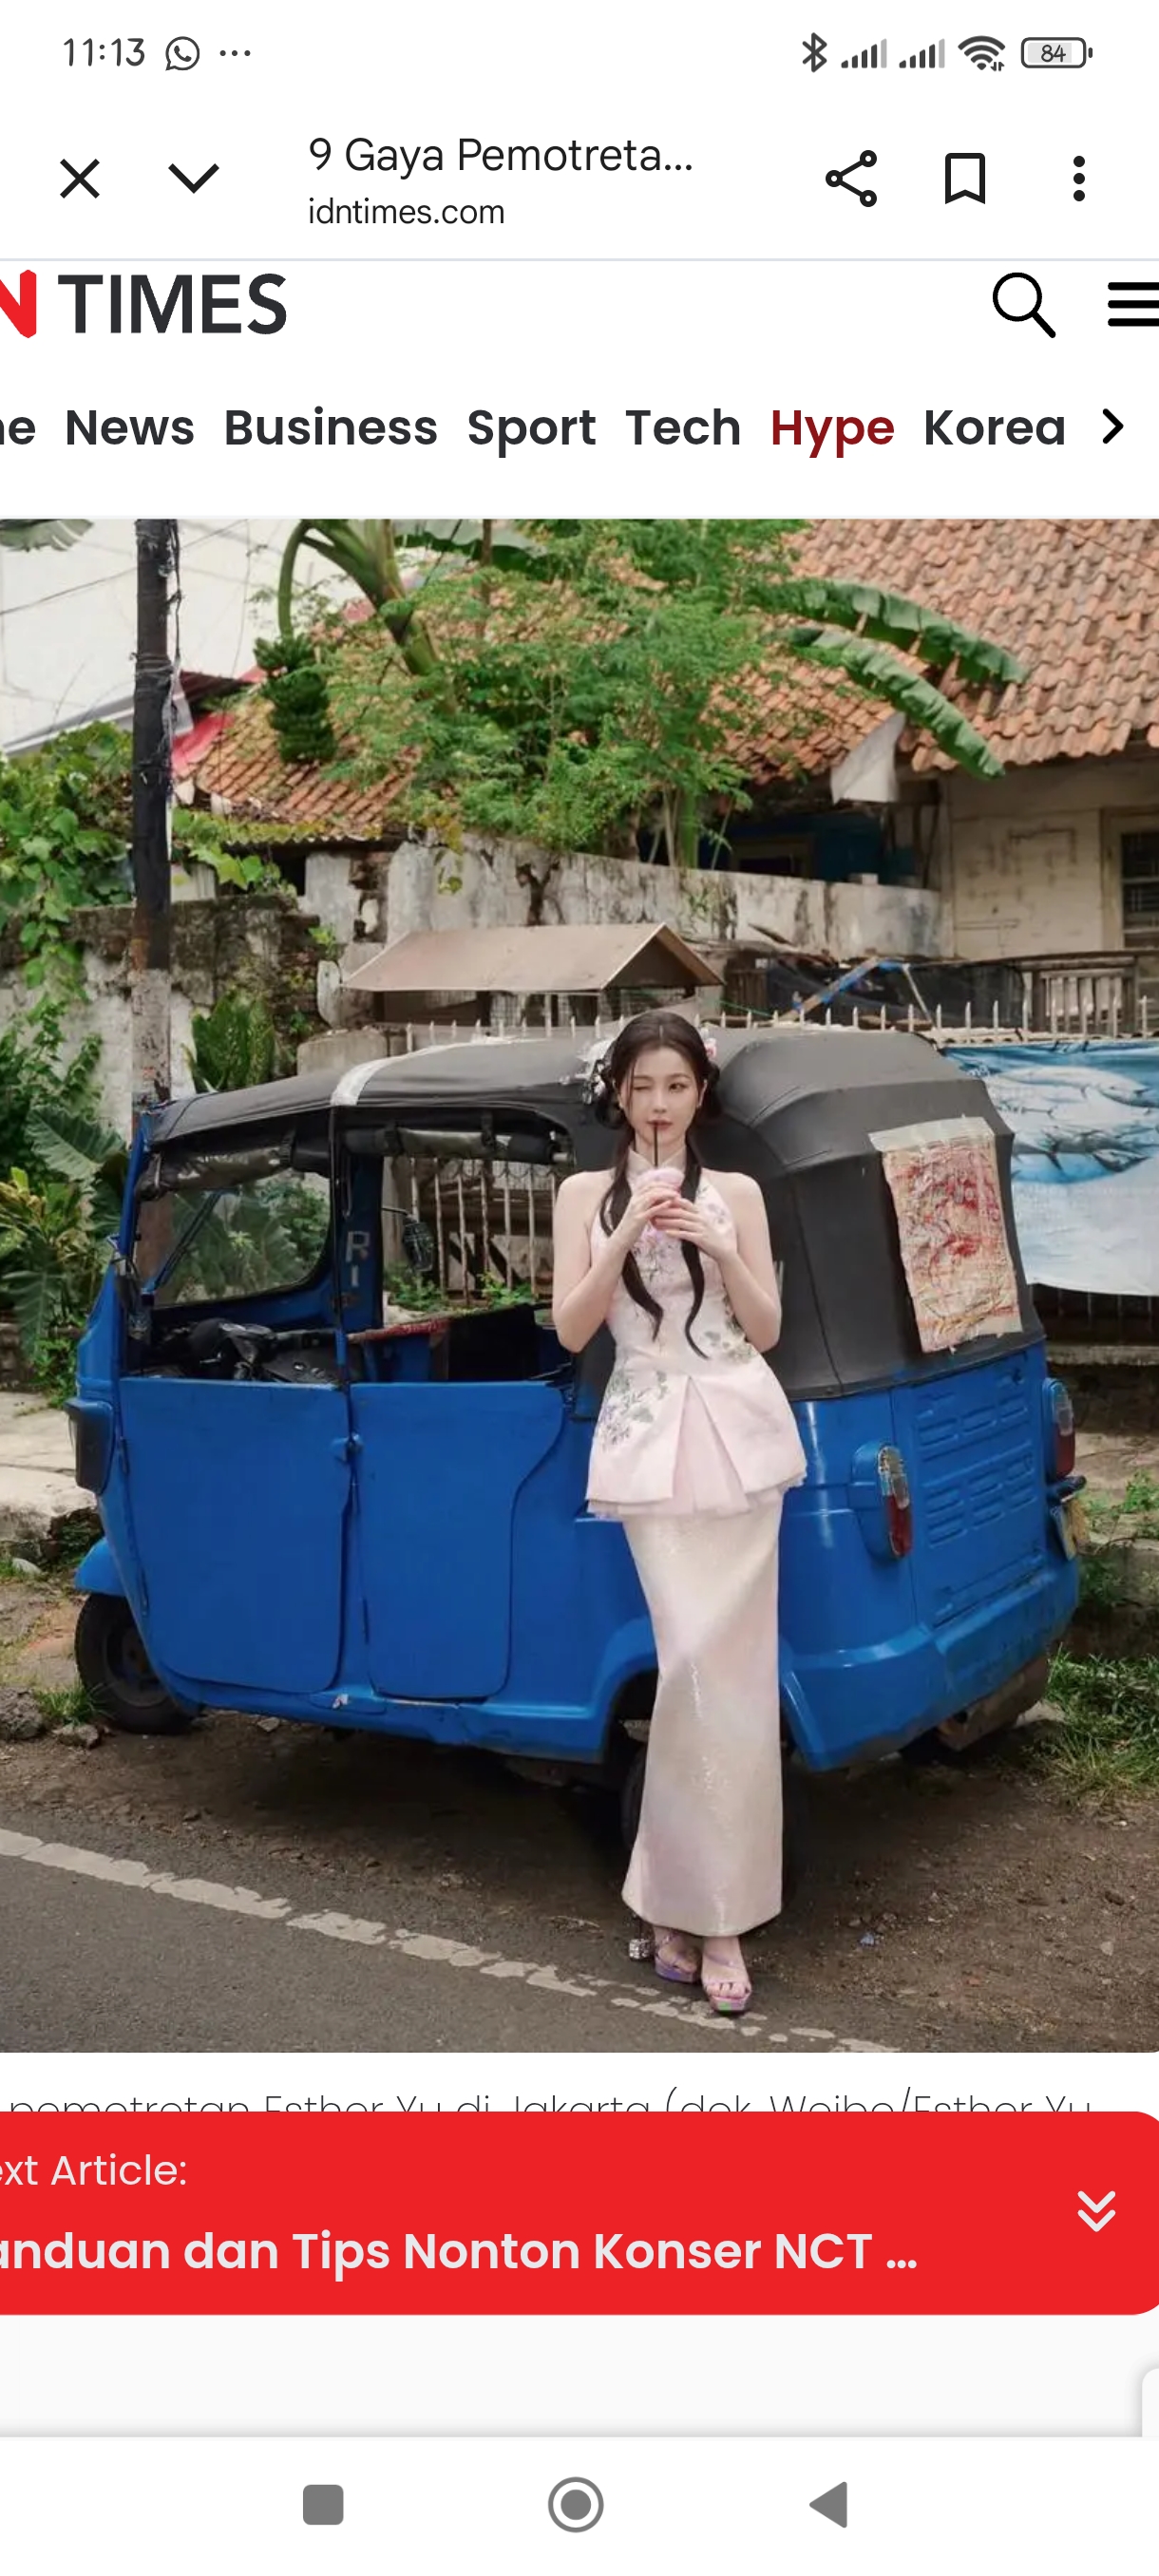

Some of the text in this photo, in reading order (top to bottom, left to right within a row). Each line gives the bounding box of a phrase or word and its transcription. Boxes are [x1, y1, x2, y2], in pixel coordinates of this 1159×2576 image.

[63, 37, 145, 67] 11:13
[1040, 44, 1067, 63] 84
[309, 137, 693, 180] 9 Gaya Pemotreta...
[309, 197, 504, 225] idntimes.com
[57, 273, 287, 335] TIMES
[66, 409, 195, 445] News
[225, 405, 438, 445] Business
[468, 408, 597, 459] Sport
[625, 407, 740, 445] Tech
[772, 409, 895, 459] Hype
[925, 409, 1065, 445] Korea
[50, 2152, 186, 2186] Article:
[183, 2231, 278, 2269] dan
[292, 2228, 390, 2282] Tips
[405, 2233, 580, 2269] Nonton
[595, 2233, 762, 2269] Konser
[775, 2232, 873, 2269] NCT
